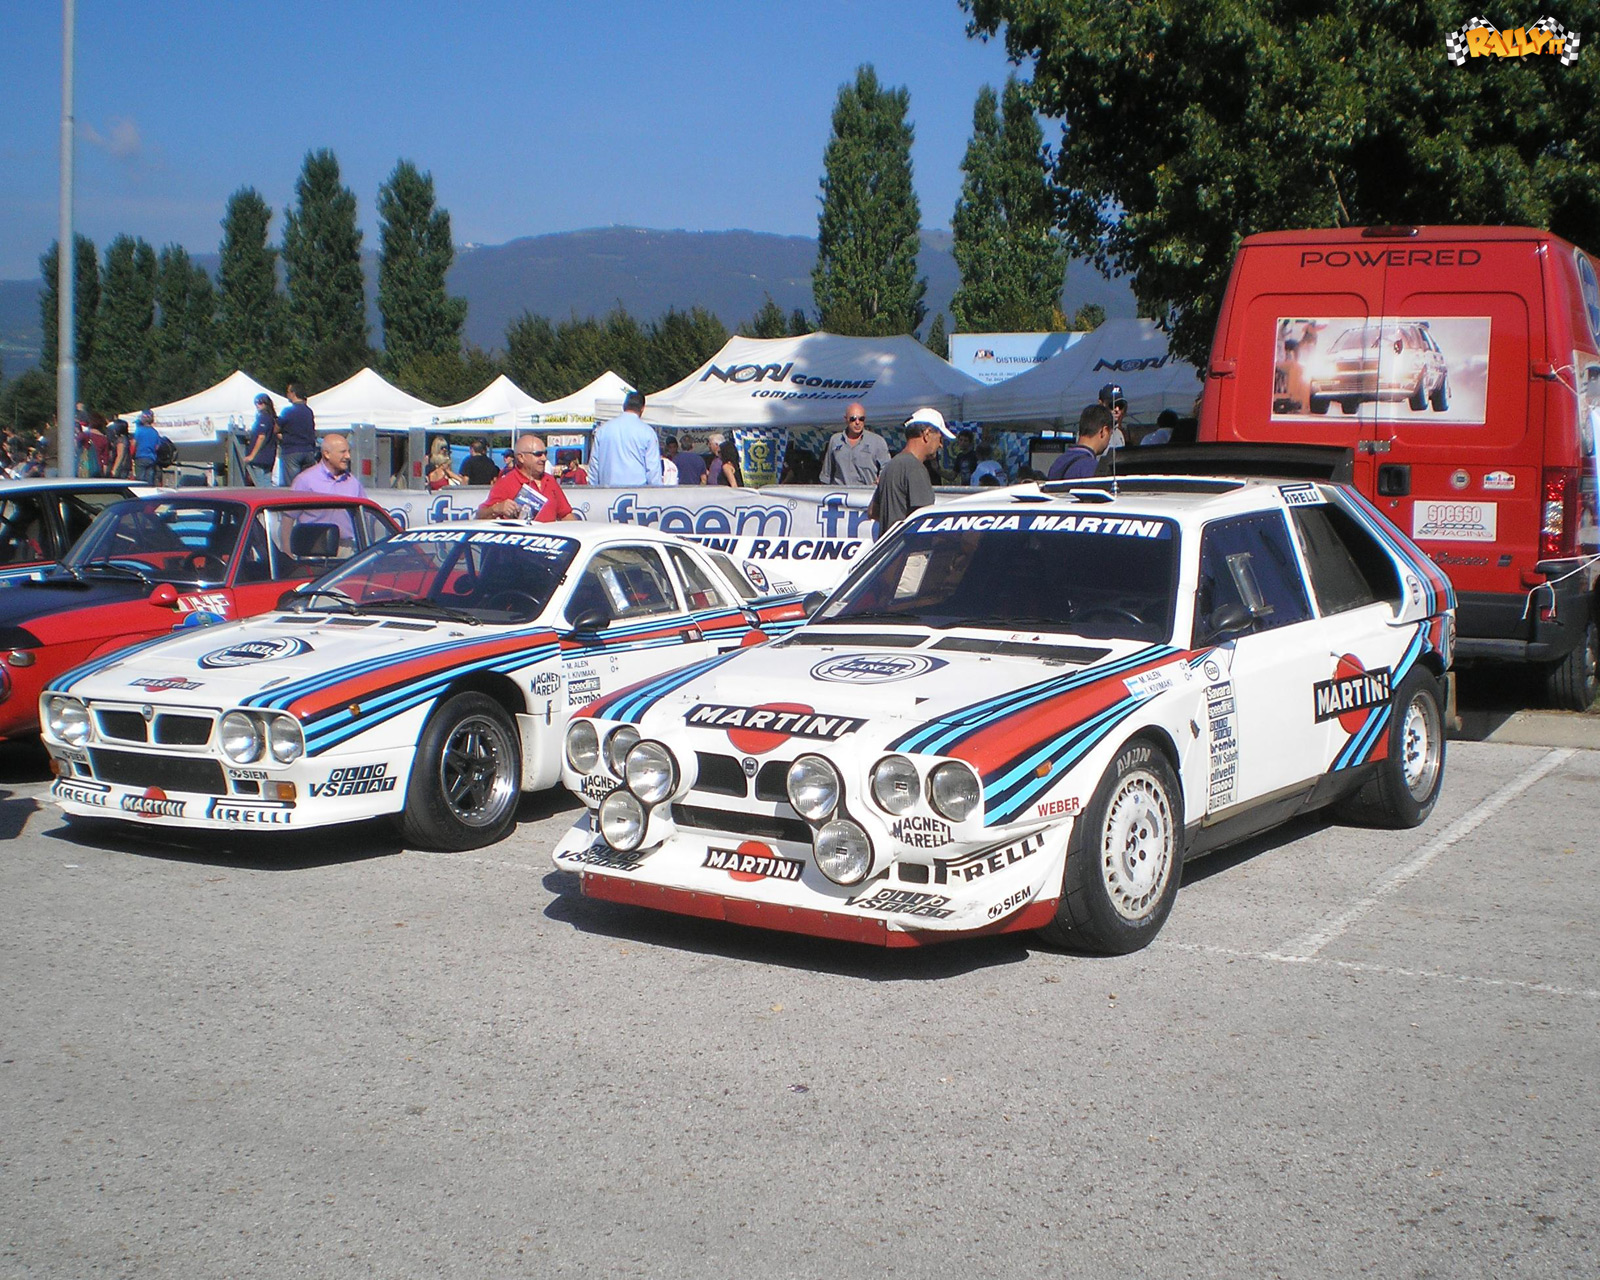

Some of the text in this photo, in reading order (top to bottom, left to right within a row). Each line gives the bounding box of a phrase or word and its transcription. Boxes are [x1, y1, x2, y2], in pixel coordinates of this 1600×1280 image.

[1301, 249, 1481, 267] POWERED
[791, 374, 876, 388] GOMME
[751, 388, 868, 401] competizioni
[1427, 505, 1482, 527] spesso
[917, 515, 1164, 538] LANCIA MARTINI
[1433, 528, 1493, 537] RACING
[387, 531, 568, 550] LANCIA MARTINI
[748, 539, 862, 561] RACING
[134, 678, 200, 690] MARTINI
[1316, 673, 1390, 716] MARTINI
[690, 706, 854, 737] MARTINI
[1210, 738, 1236, 754] brembo
[1116, 747, 1152, 778] AVON
[243, 770, 269, 780] SIEM
[330, 763, 387, 782] OLIO
[1210, 763, 1236, 782] olivetti
[122, 796, 183, 816] MARTINI
[1037, 797, 1080, 817] WEBER
[892, 816, 952, 838] MAGNETI
[706, 850, 799, 878] MARTINI
[874, 889, 950, 906] OLIO
[1003, 885, 1032, 910] SIEM
